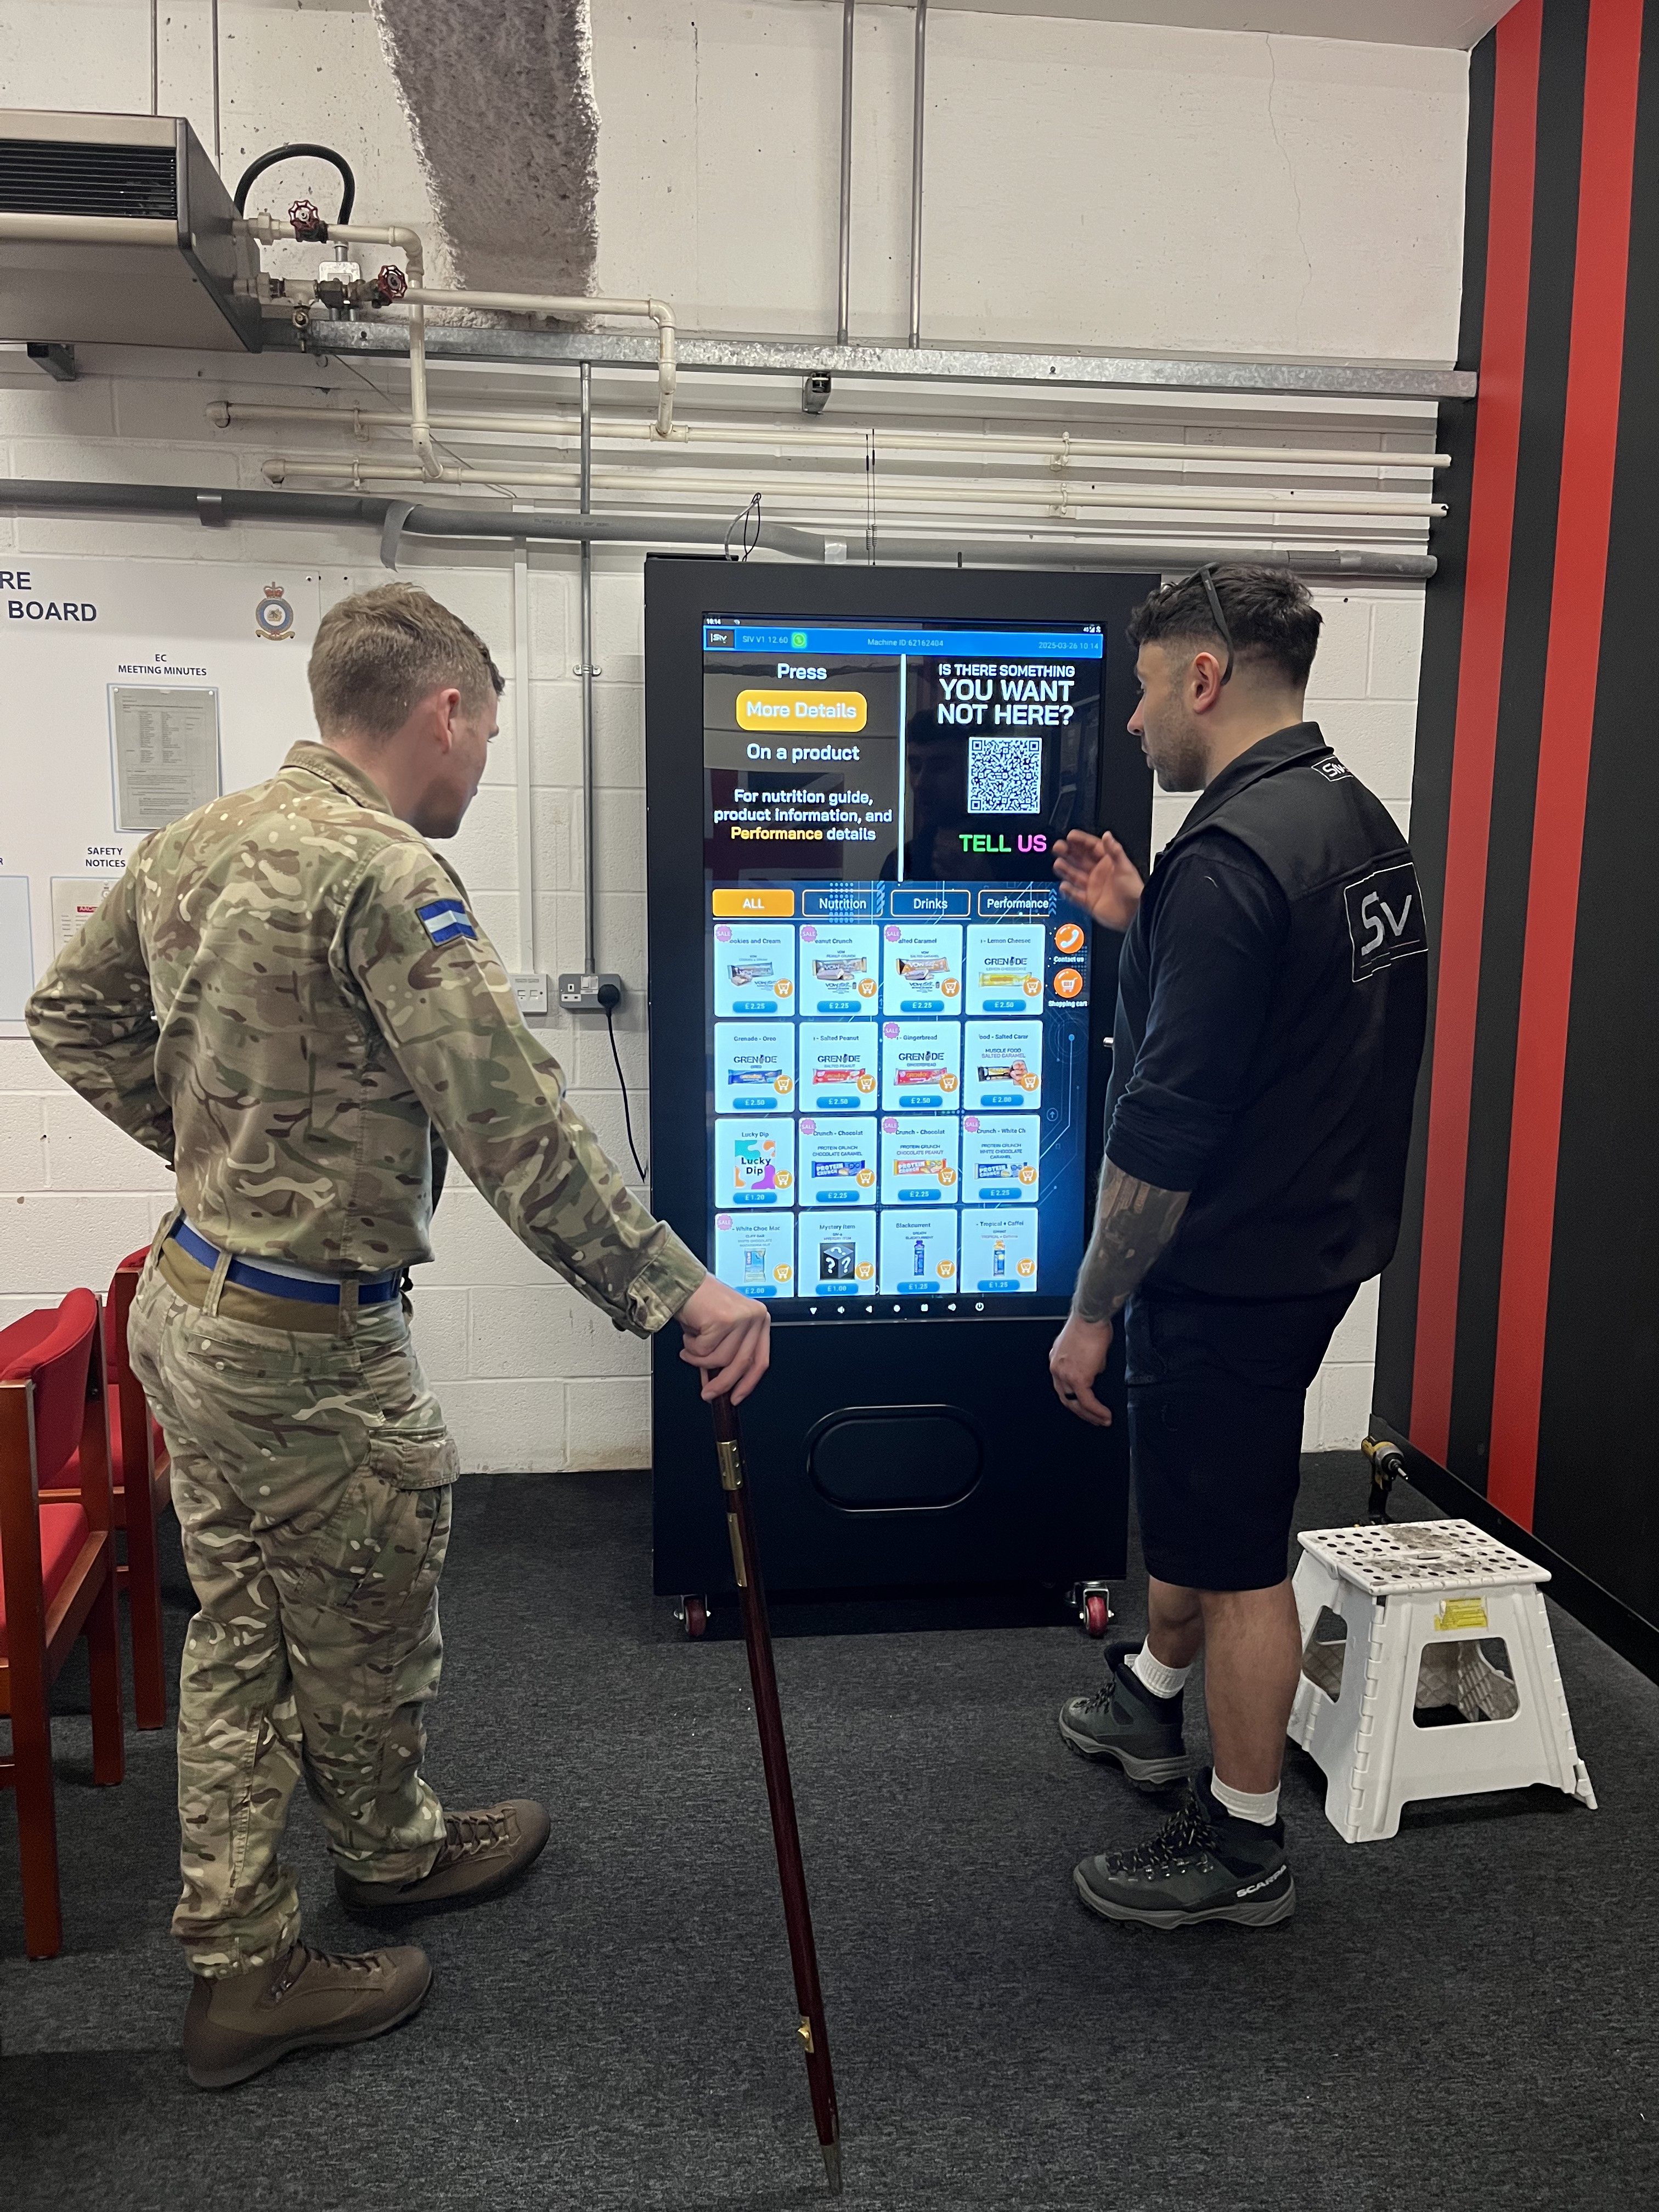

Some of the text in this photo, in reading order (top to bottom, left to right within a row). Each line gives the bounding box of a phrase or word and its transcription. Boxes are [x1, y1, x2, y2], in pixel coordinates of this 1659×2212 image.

[8, 601, 97, 622] BOARD
[155, 654, 167, 662] EC
[118, 665, 207, 676] MEETING MINUTES
[777, 663, 827, 680] Press
[939, 664, 1075, 677] IS THERE SOMETHING
[939, 679, 1074, 702] YOU WANT
[747, 701, 856, 718] More Details
[938, 703, 1074, 725] NOT HERE?
[747, 743, 860, 764] On a product
[734, 789, 873, 806] For nutrition guide,
[714, 808, 893, 824] product information, and
[731, 827, 876, 841] Performance details
[959, 834, 1047, 852] TELL US
[743, 899, 764, 909] ALL
[819, 898, 866, 909] Nutrition
[913, 898, 948, 910] Drinks
[987, 899, 1049, 909] Performance
[741, 1157, 771, 1166] Lucky
[746, 1166, 763, 1176] Dip
[1237, 1865, 1287, 1898] SCARPA
